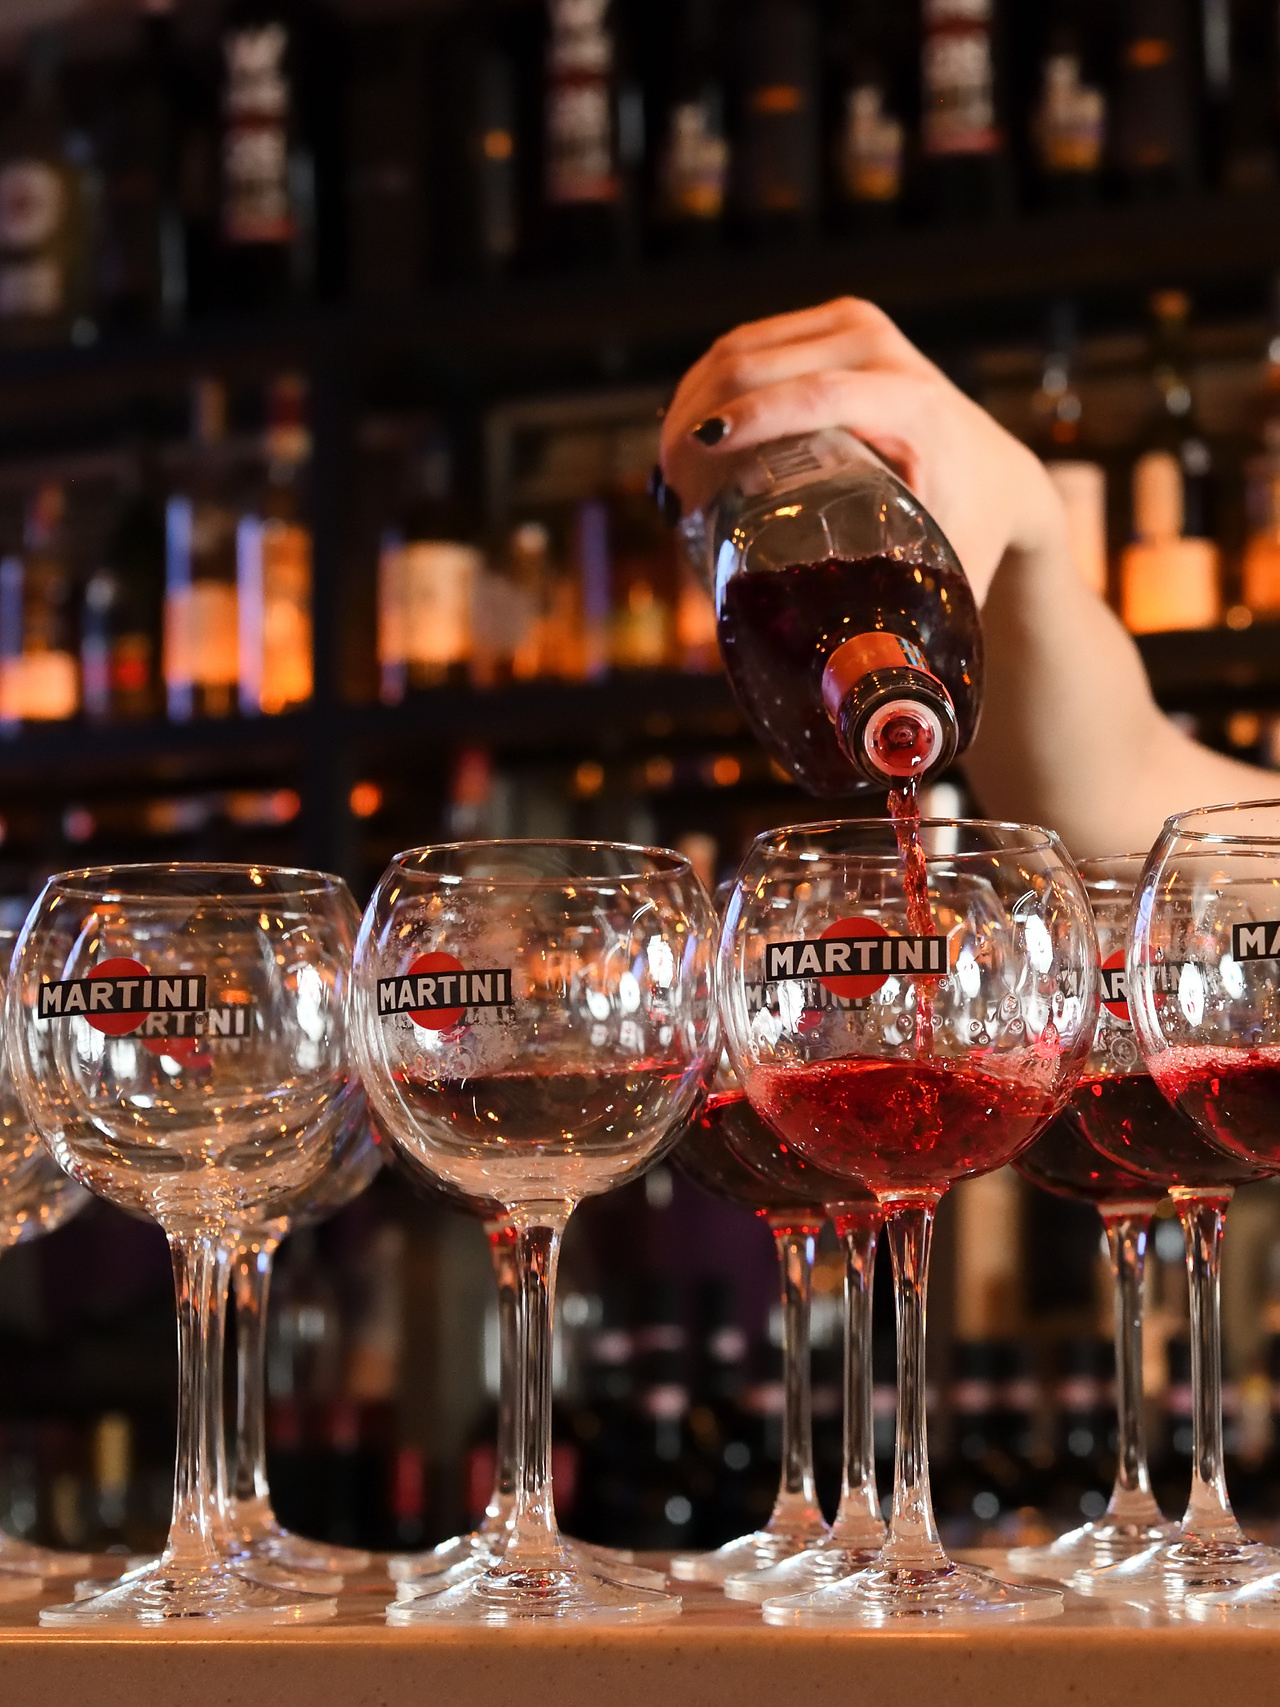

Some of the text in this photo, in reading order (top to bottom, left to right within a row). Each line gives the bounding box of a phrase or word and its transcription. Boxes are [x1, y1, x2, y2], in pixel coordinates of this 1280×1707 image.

[771, 940, 940, 977] MARTINI
[42, 979, 199, 1015] MARTINI
[380, 973, 505, 1012] MARTINI
[135, 1008, 245, 1036] RTINI
